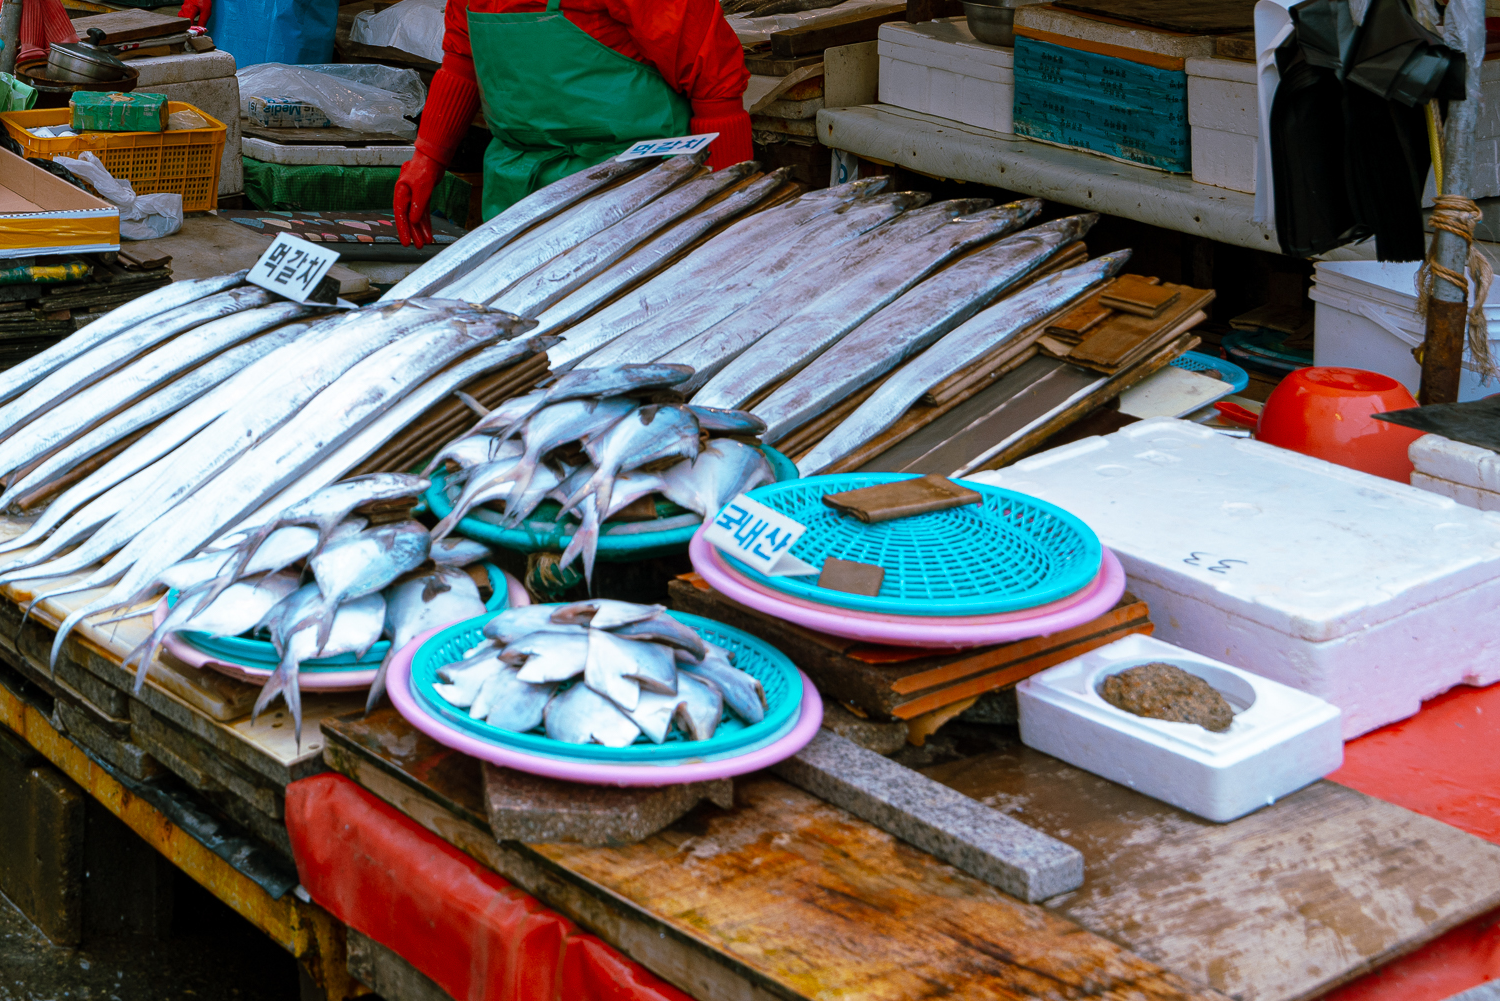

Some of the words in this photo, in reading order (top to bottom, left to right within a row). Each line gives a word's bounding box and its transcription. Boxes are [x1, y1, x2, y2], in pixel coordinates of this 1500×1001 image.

[630, 137, 707, 155] 먹갈치
[264, 242, 327, 291] 먹갈치
[716, 504, 792, 561] 국내산
